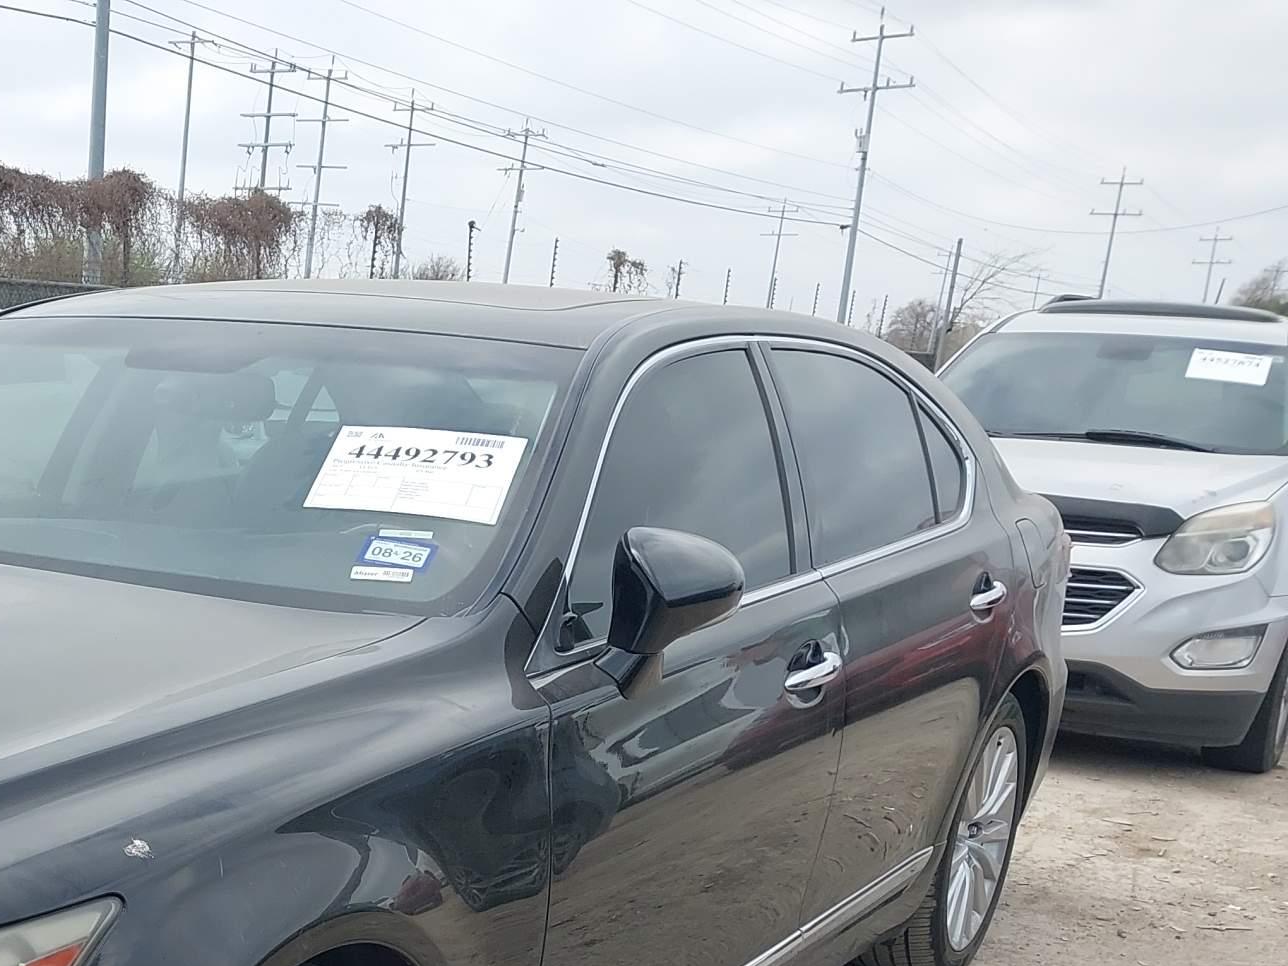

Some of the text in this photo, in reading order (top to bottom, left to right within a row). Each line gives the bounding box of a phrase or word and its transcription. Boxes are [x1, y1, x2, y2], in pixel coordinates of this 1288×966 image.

[348, 444, 494, 469] 44492793
[370, 546, 394, 558] 08
[399, 550, 424, 563] 26
